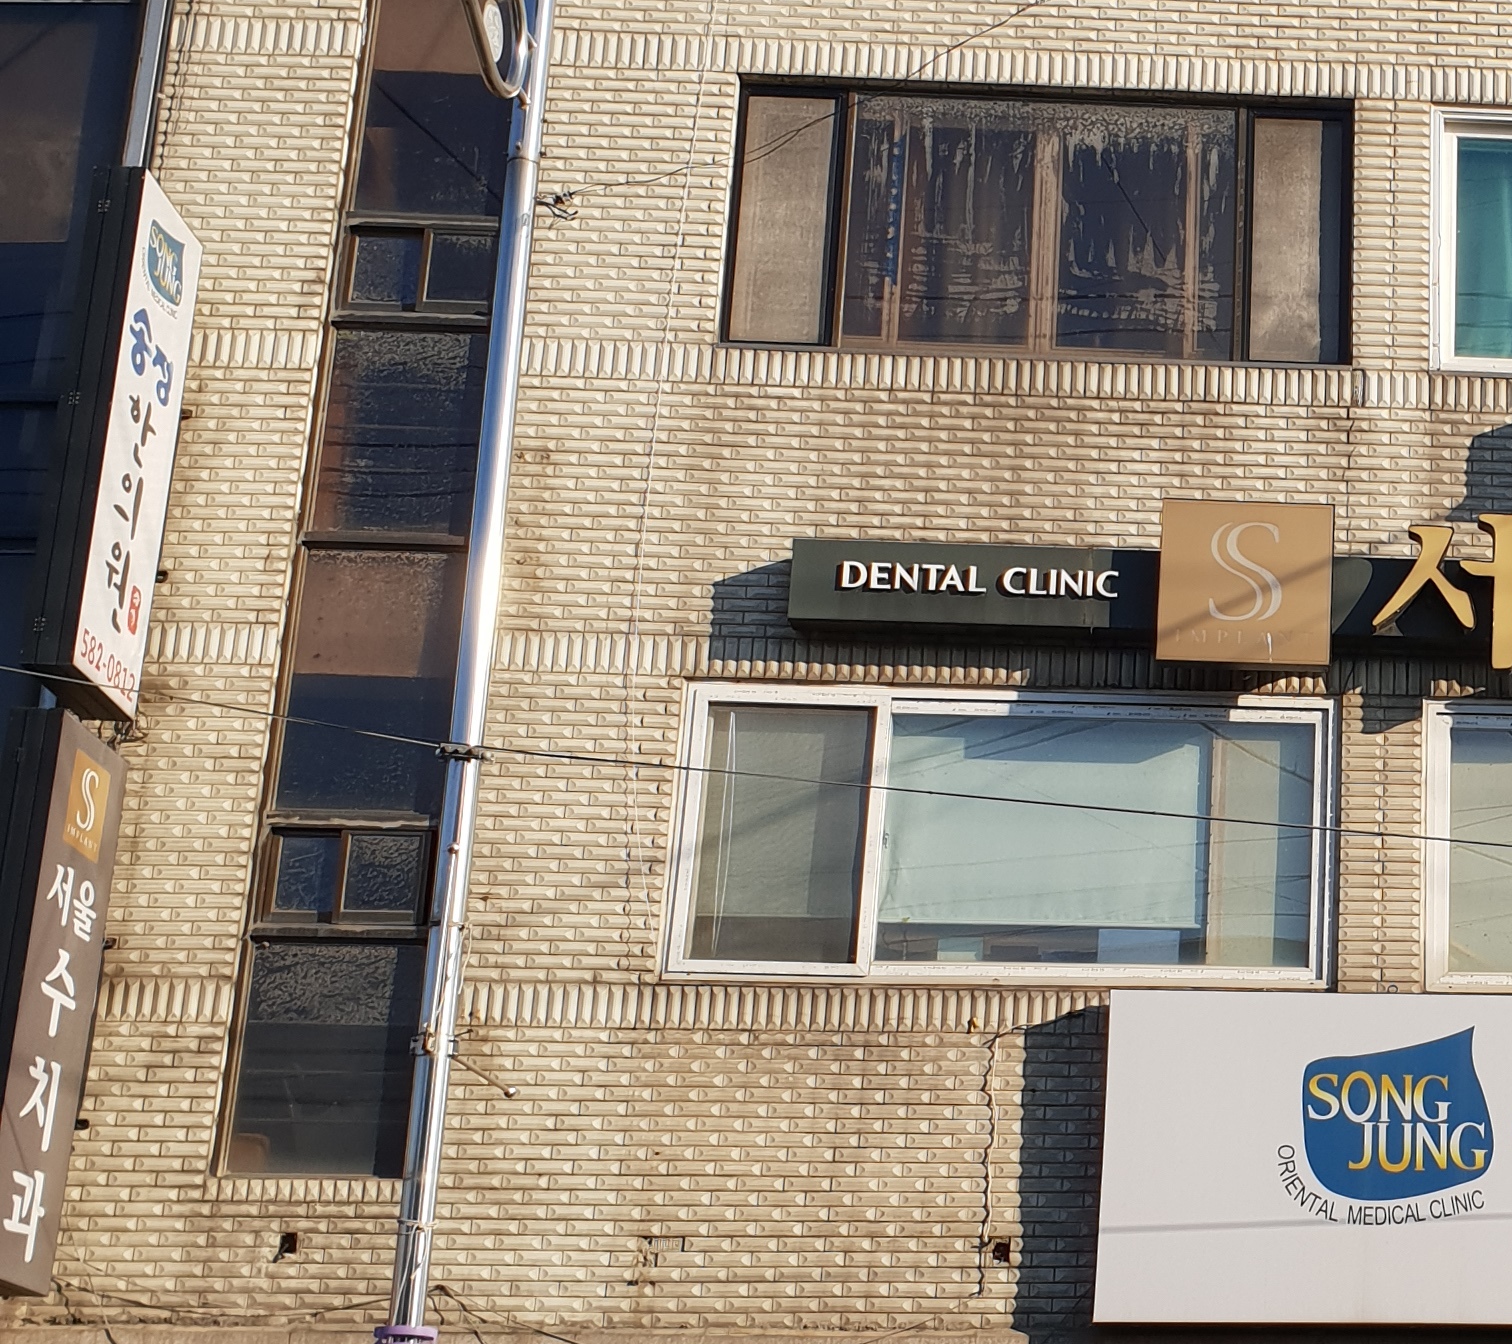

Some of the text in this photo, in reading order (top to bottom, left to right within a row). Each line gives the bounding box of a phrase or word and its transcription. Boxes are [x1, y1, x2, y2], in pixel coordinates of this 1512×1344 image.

[150, 226, 178, 275] SONG
[154, 257, 182, 304] JUNG
[840, 560, 1120, 599] DENTAL CLINIC
[80, 628, 137, 703] 582-0812
[1307, 1070, 1452, 1122] SONG
[1347, 1120, 1486, 1174] JUNG
[1277, 1144, 1485, 1226] ORIENTAL MEDICAL CLINIC
